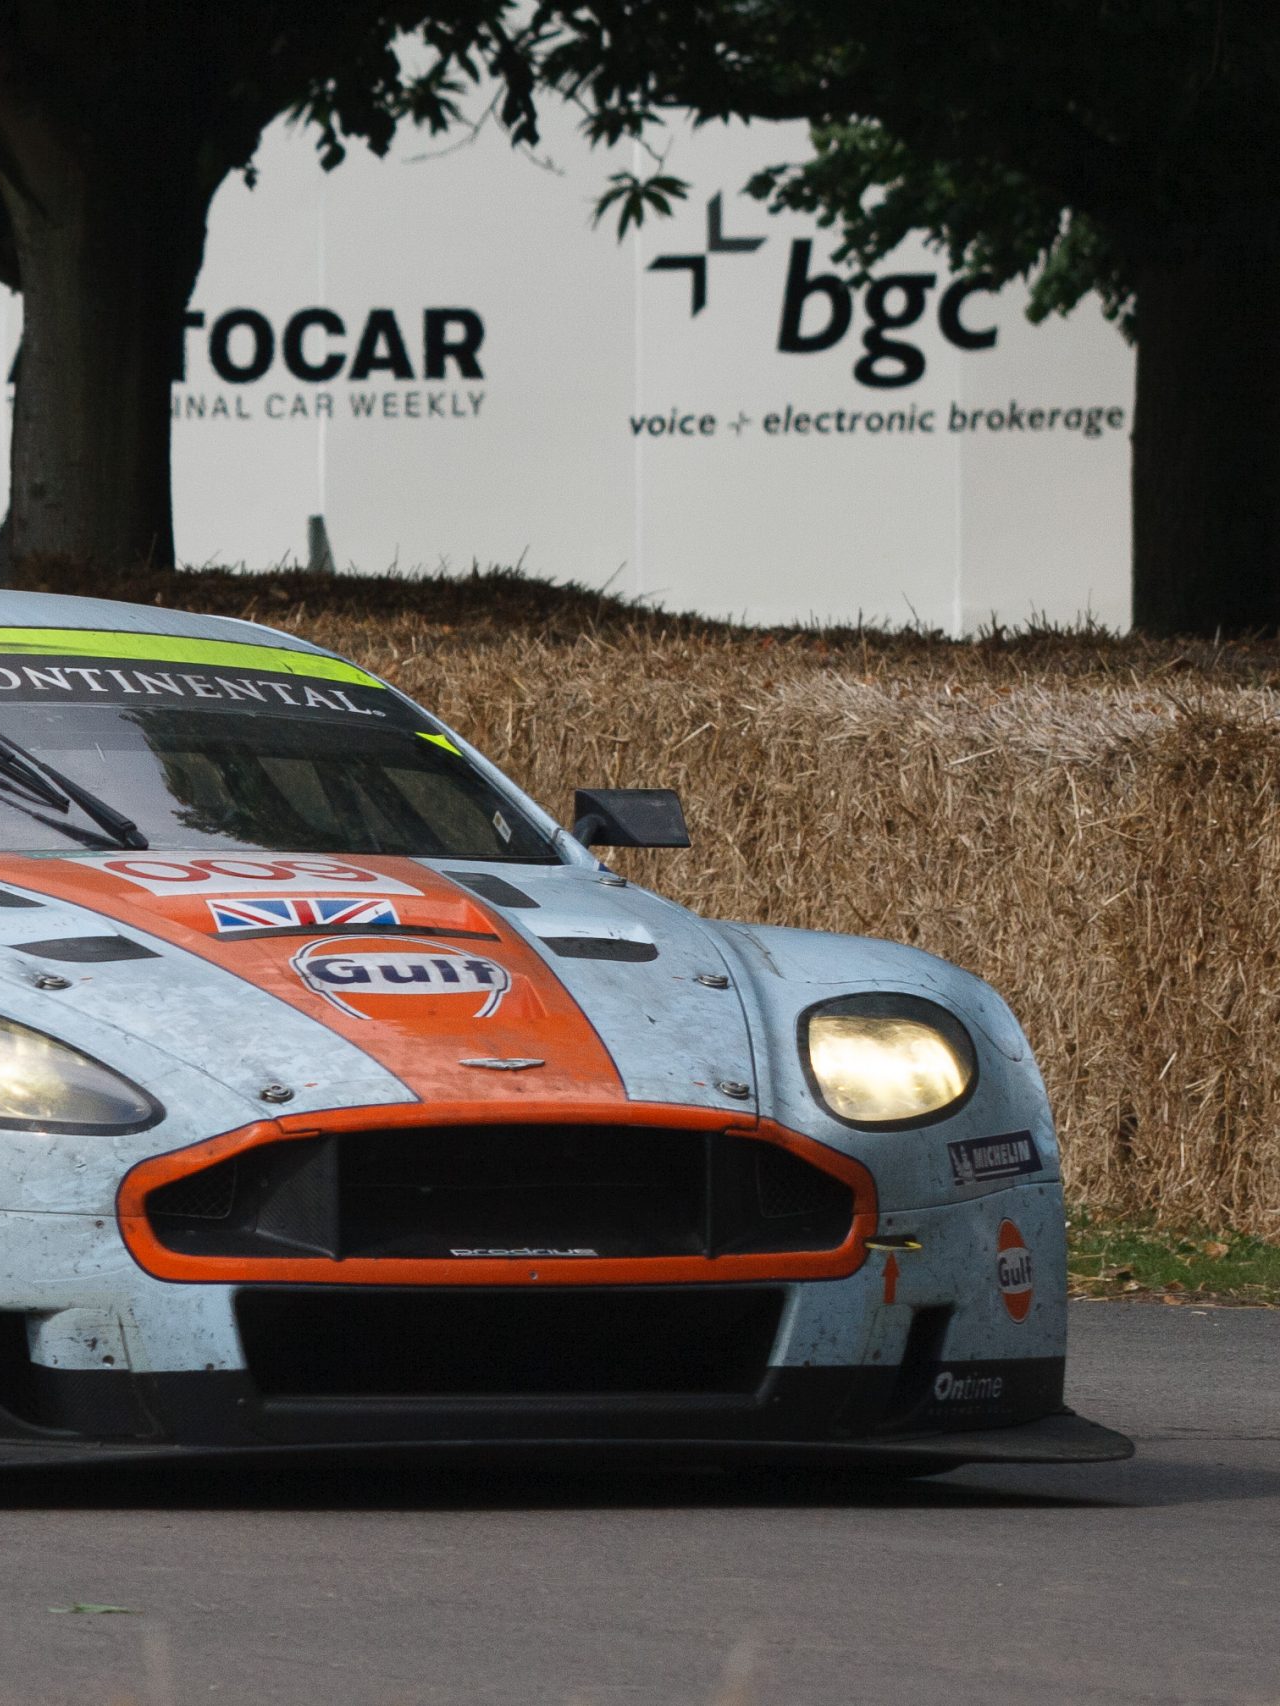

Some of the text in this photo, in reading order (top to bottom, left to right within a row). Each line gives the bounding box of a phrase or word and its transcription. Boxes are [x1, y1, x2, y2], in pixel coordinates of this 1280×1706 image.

[777, 238, 998, 388] bgc
[265, 392, 334, 418] CAR
[349, 391, 486, 418] WEEKLY
[629, 407, 716, 436] voice
[763, 404, 935, 434] electronic
[948, 401, 1124, 439] brokerage
[104, 858, 378, 883] 009
[306, 957, 499, 985] Gulf
[972, 1139, 1031, 1170] MICHELIN
[998, 1253, 1032, 1288] Gulf
[934, 1371, 1003, 1401] Ontime
